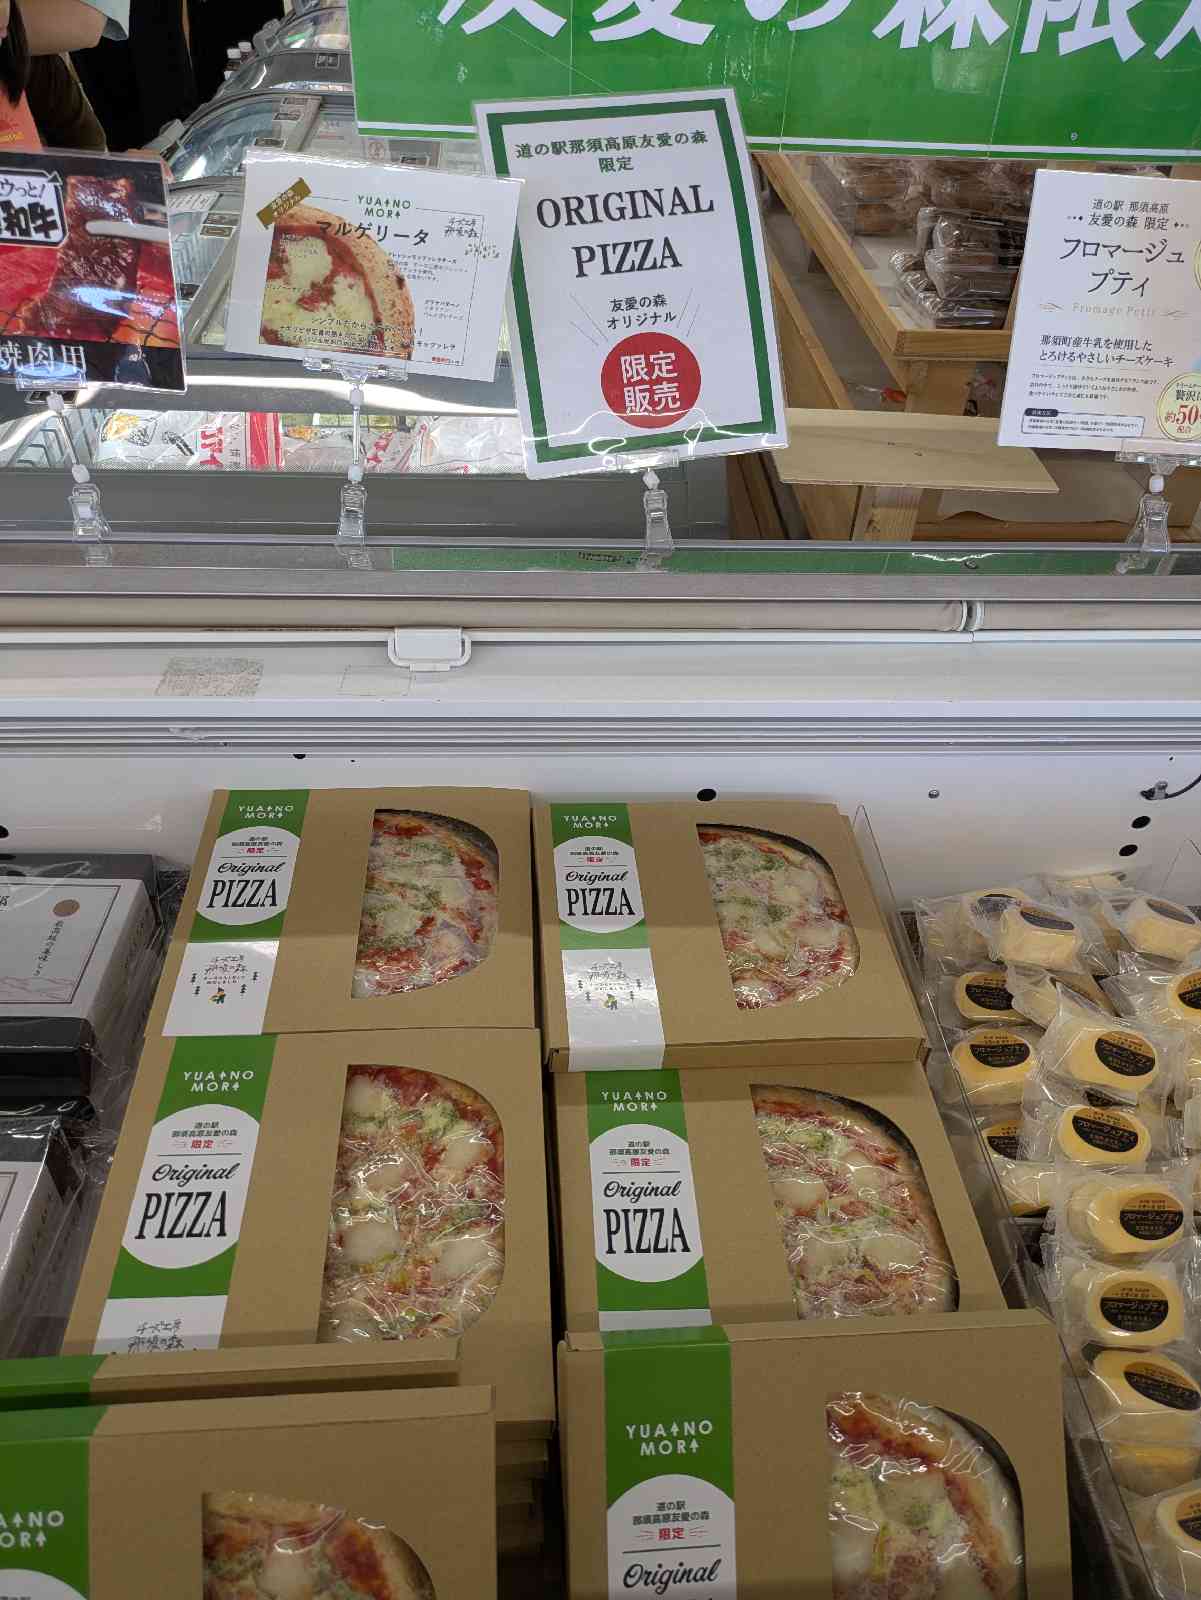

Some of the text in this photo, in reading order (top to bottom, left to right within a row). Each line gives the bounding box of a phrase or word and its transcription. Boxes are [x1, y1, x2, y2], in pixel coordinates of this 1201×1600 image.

[515, 130, 708, 159] 道の駅那須高原友愛の森
[598, 156, 634, 173] 限定
[536, 184, 715, 229] ORIGINAL
[1092, 198, 1124, 211] 道の駅
[316, 220, 429, 246] マルゲリータ
[1088, 213, 1170, 231] 友愛の森 限定
[572, 236, 682, 278] PIZZA
[1059, 238, 1185, 264] フロマージュ
[1087, 268, 1150, 298] プティ
[610, 294, 668, 313] 友愛の森
[607, 311, 676, 330] オリジナル
[1040, 334, 1153, 352] 那須町産牛乳を使用した
[620, 350, 678, 384] 限定
[1039, 350, 1176, 369] とろけるやさしいチーズケーキ
[624, 381, 681, 416] 販売
[217, 862, 285, 876] Original
[565, 871, 629, 886] Original
[206, 879, 277, 908] PIZZA
[565, 887, 635, 917] PIZZA
[190, 1139, 214, 1149] 限定
[629, 1157, 651, 1167] 限定
[151, 1162, 241, 1188] Original
[603, 1180, 682, 1204] Original
[134, 1190, 227, 1240] PIZZA
[603, 1207, 691, 1255] PIZZA
[656, 1500, 686, 1512] 道の駅
[658, 1527, 685, 1541] 限定
[622, 1558, 723, 1595] Original
